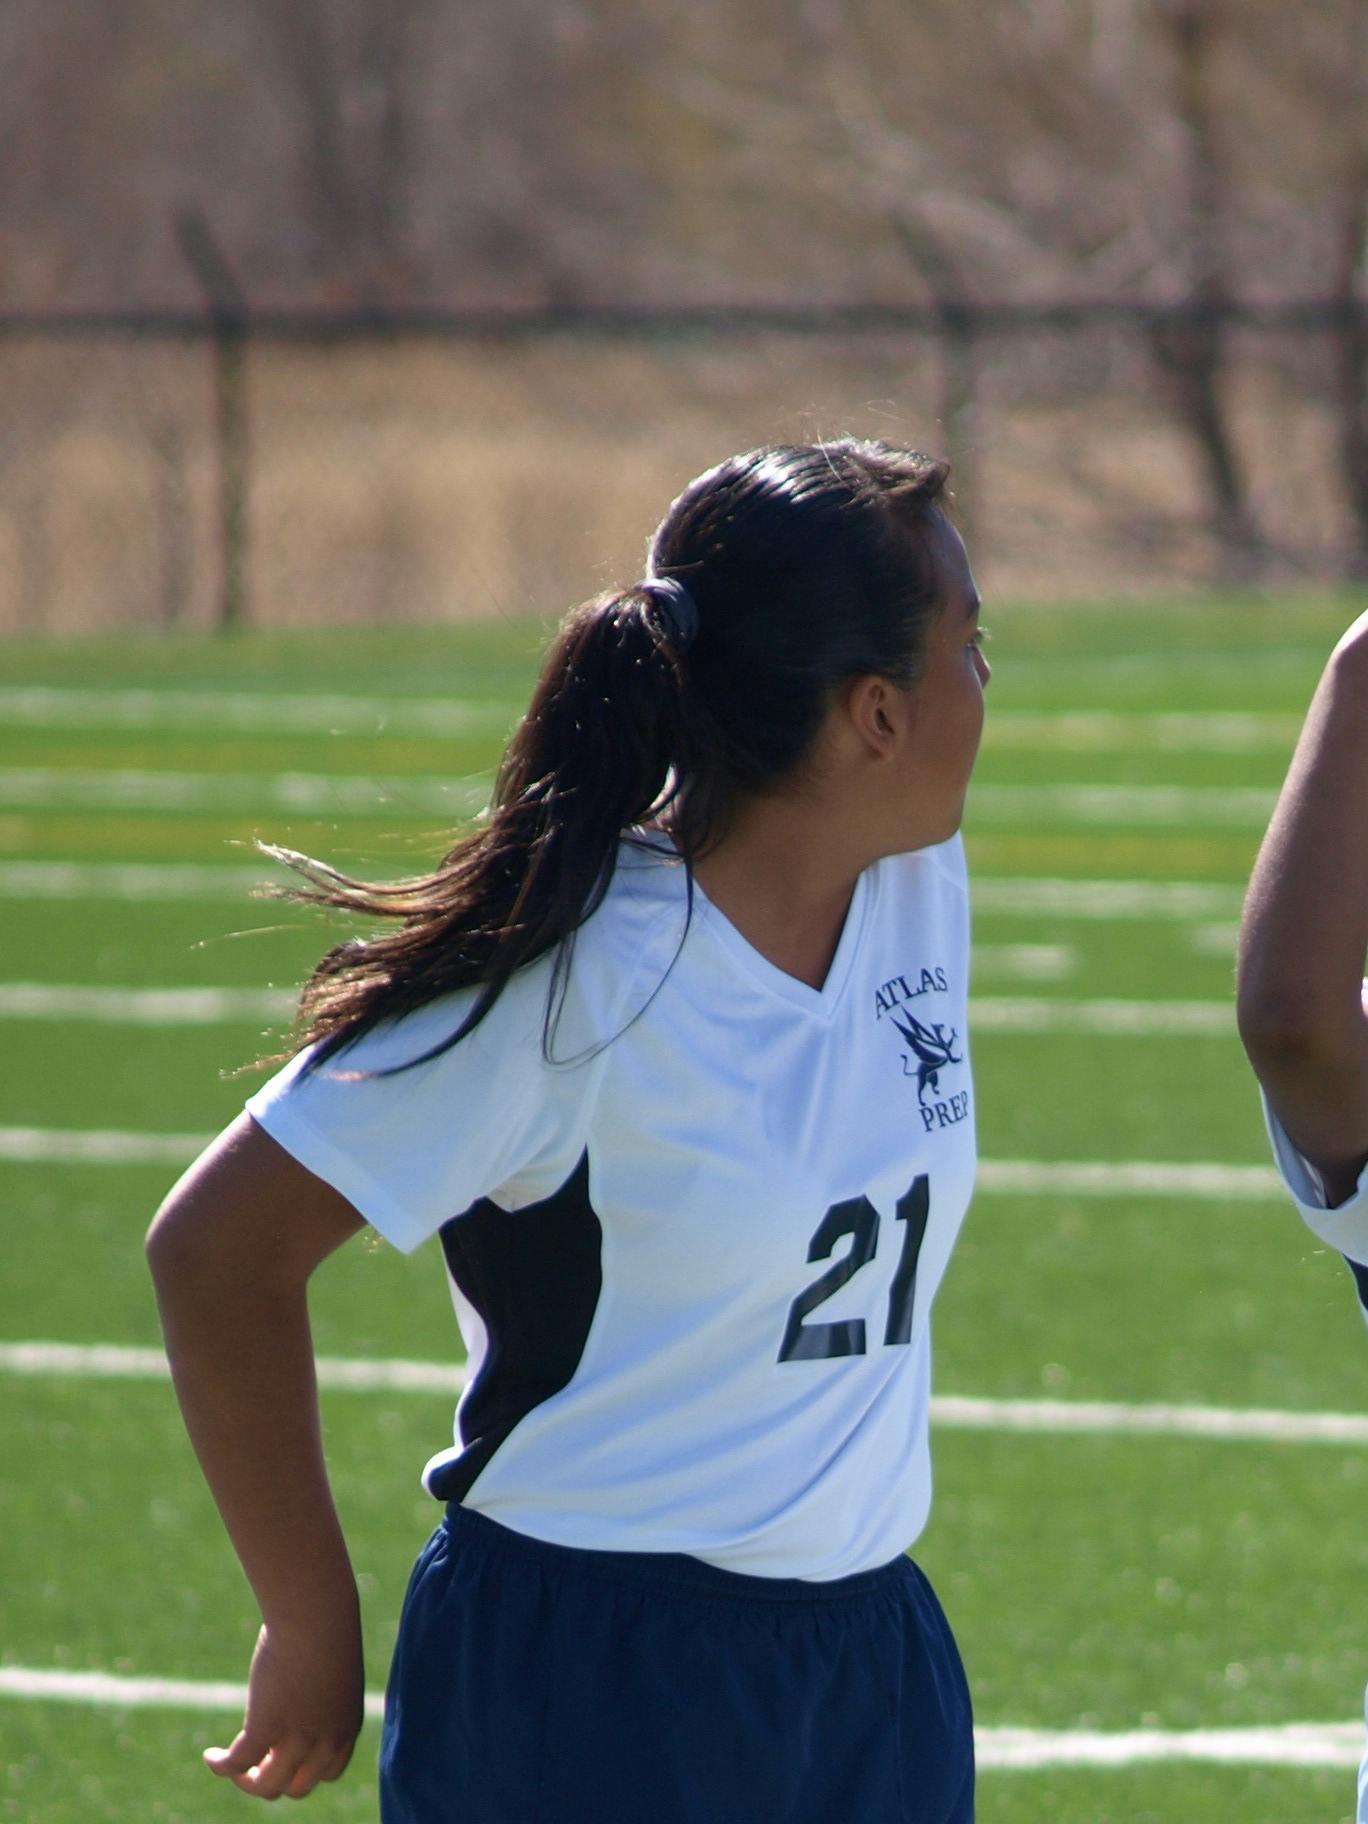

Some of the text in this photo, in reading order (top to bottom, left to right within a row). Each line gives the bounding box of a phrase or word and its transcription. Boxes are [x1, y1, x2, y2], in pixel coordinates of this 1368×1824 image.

[874, 966, 949, 1021] ATLAS
[918, 1090, 969, 1133] PREP
[776, 1172, 931, 1363] 21
